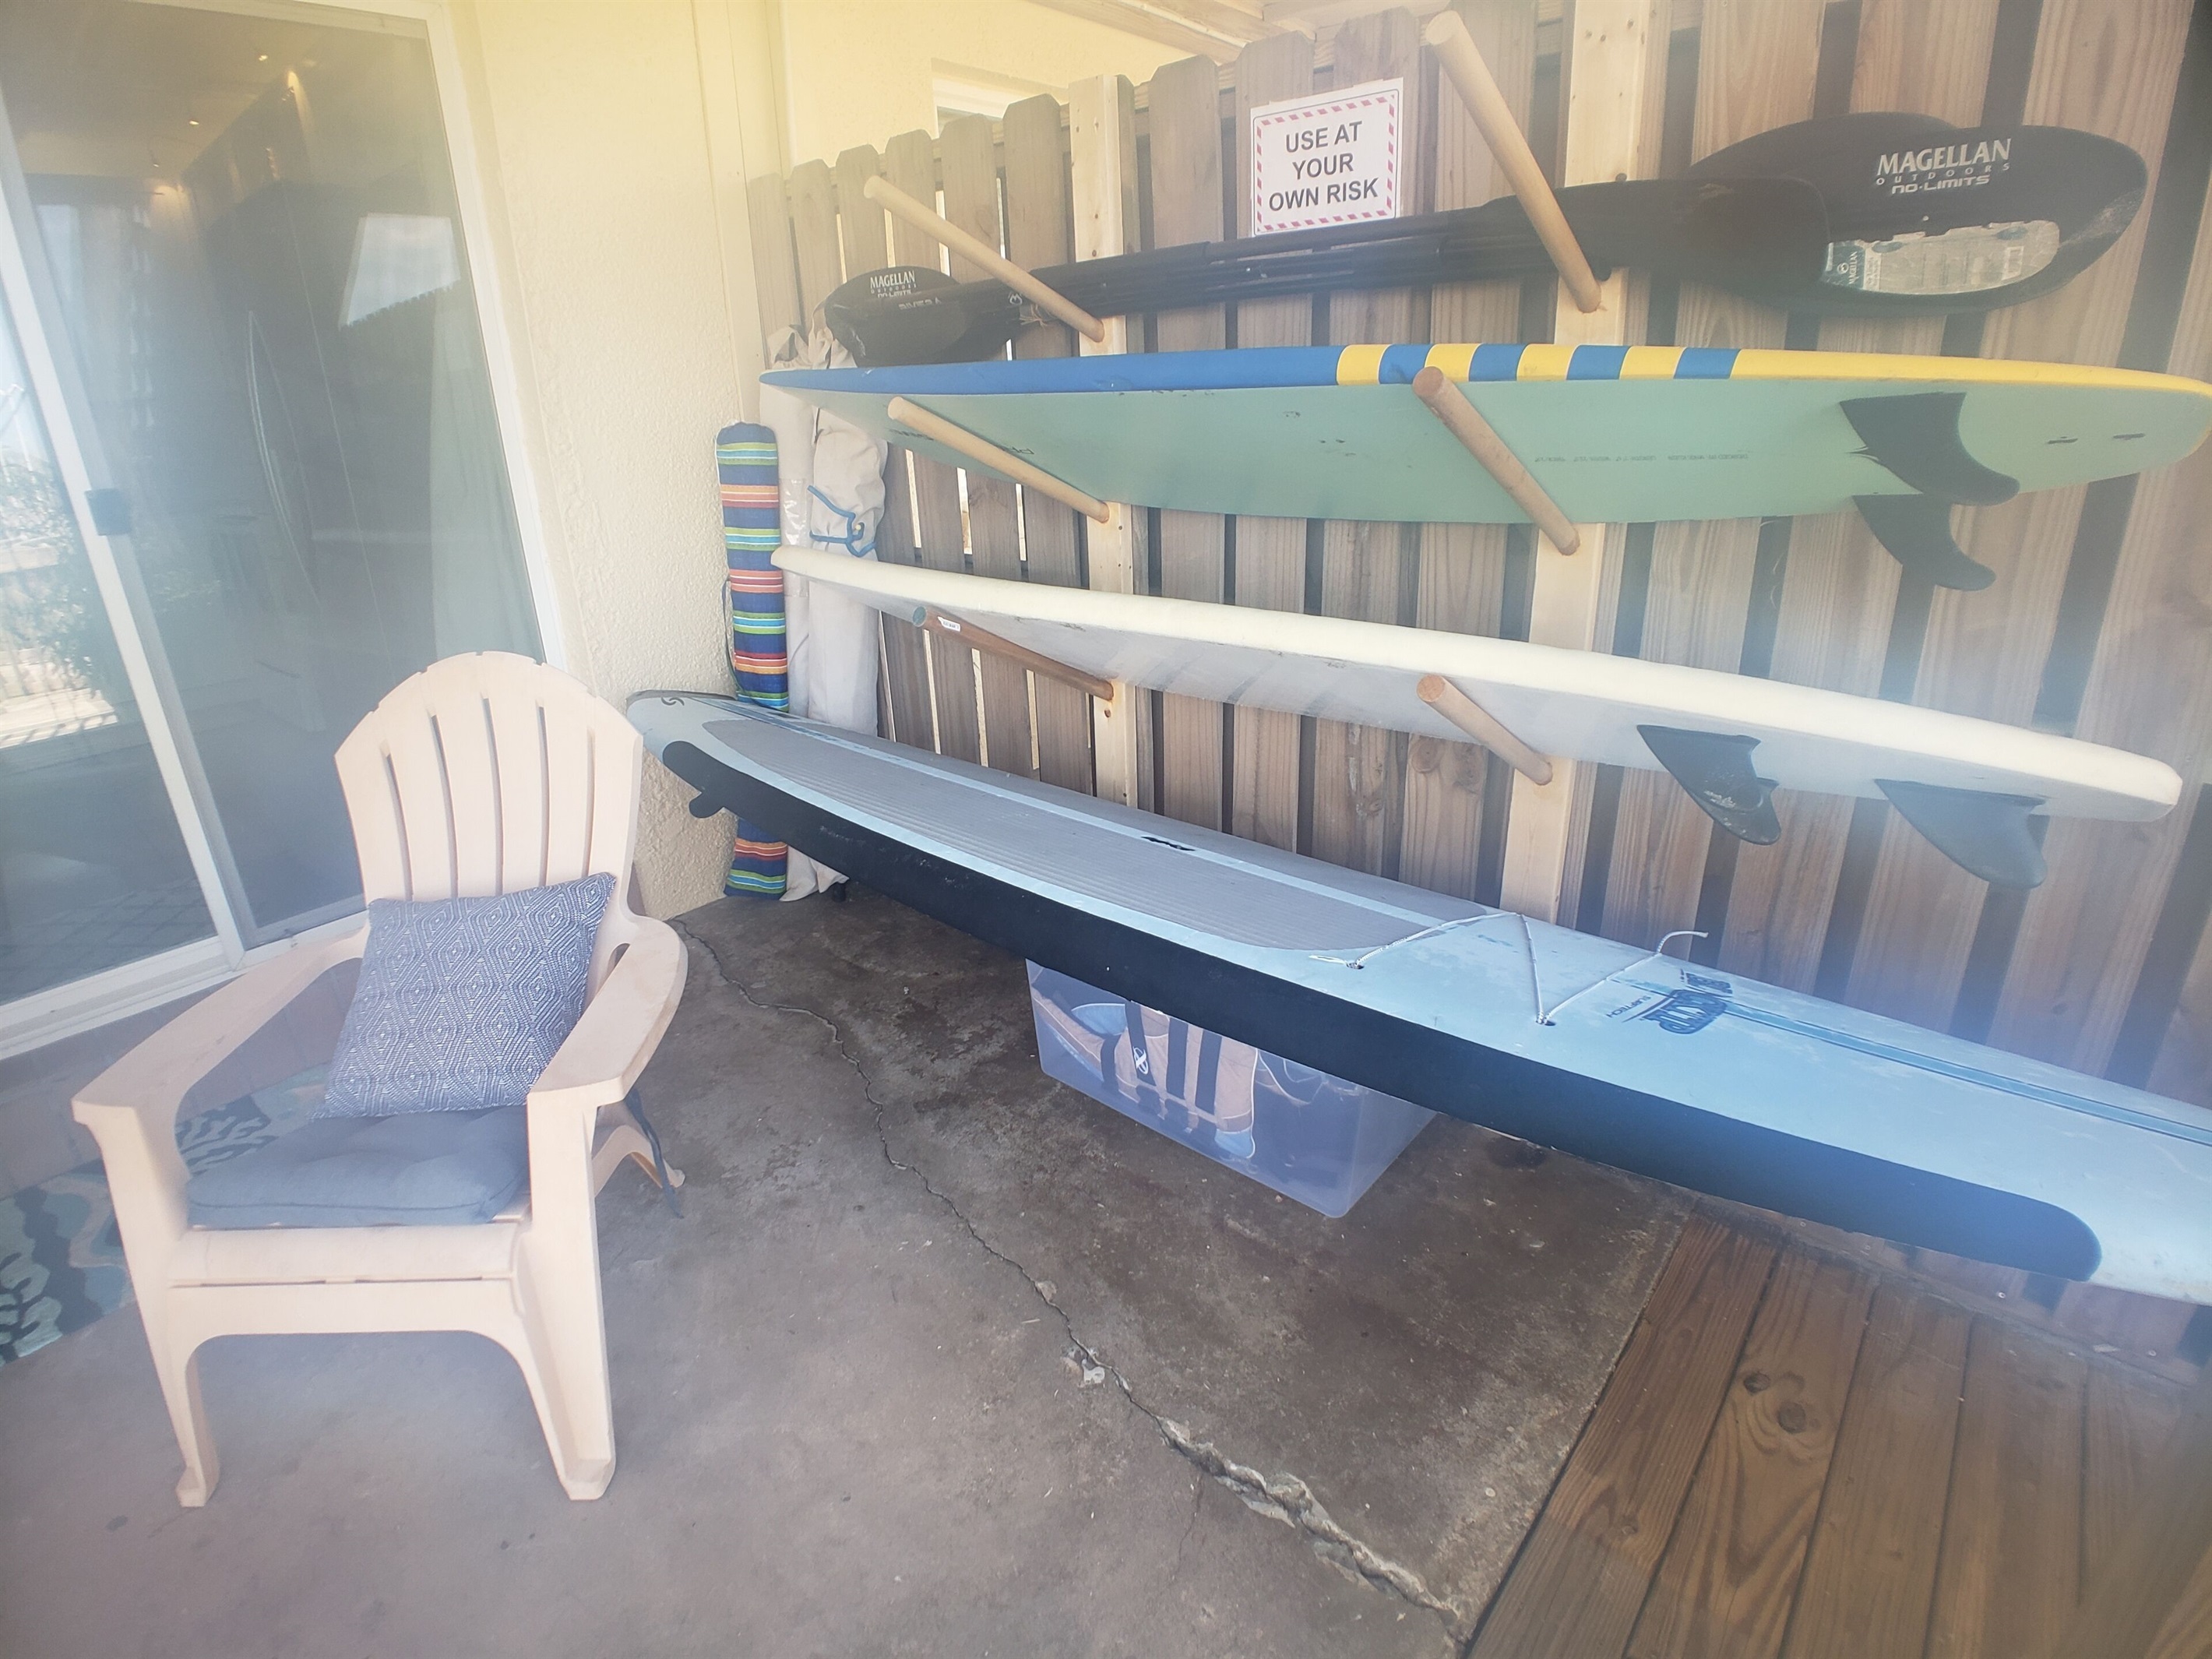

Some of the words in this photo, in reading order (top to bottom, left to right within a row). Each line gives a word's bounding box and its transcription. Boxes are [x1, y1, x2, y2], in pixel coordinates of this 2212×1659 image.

[1285, 127, 1329, 153] USE
[1334, 121, 1363, 146] AT
[1291, 153, 1354, 180] YOUR
[1876, 138, 2012, 176] MAGELLAN
[1876, 162, 2011, 186] OUTDOORS
[1268, 186, 1319, 212] OWN
[1326, 178, 1379, 204] RISK
[870, 269, 916, 289] MAGELLAN
